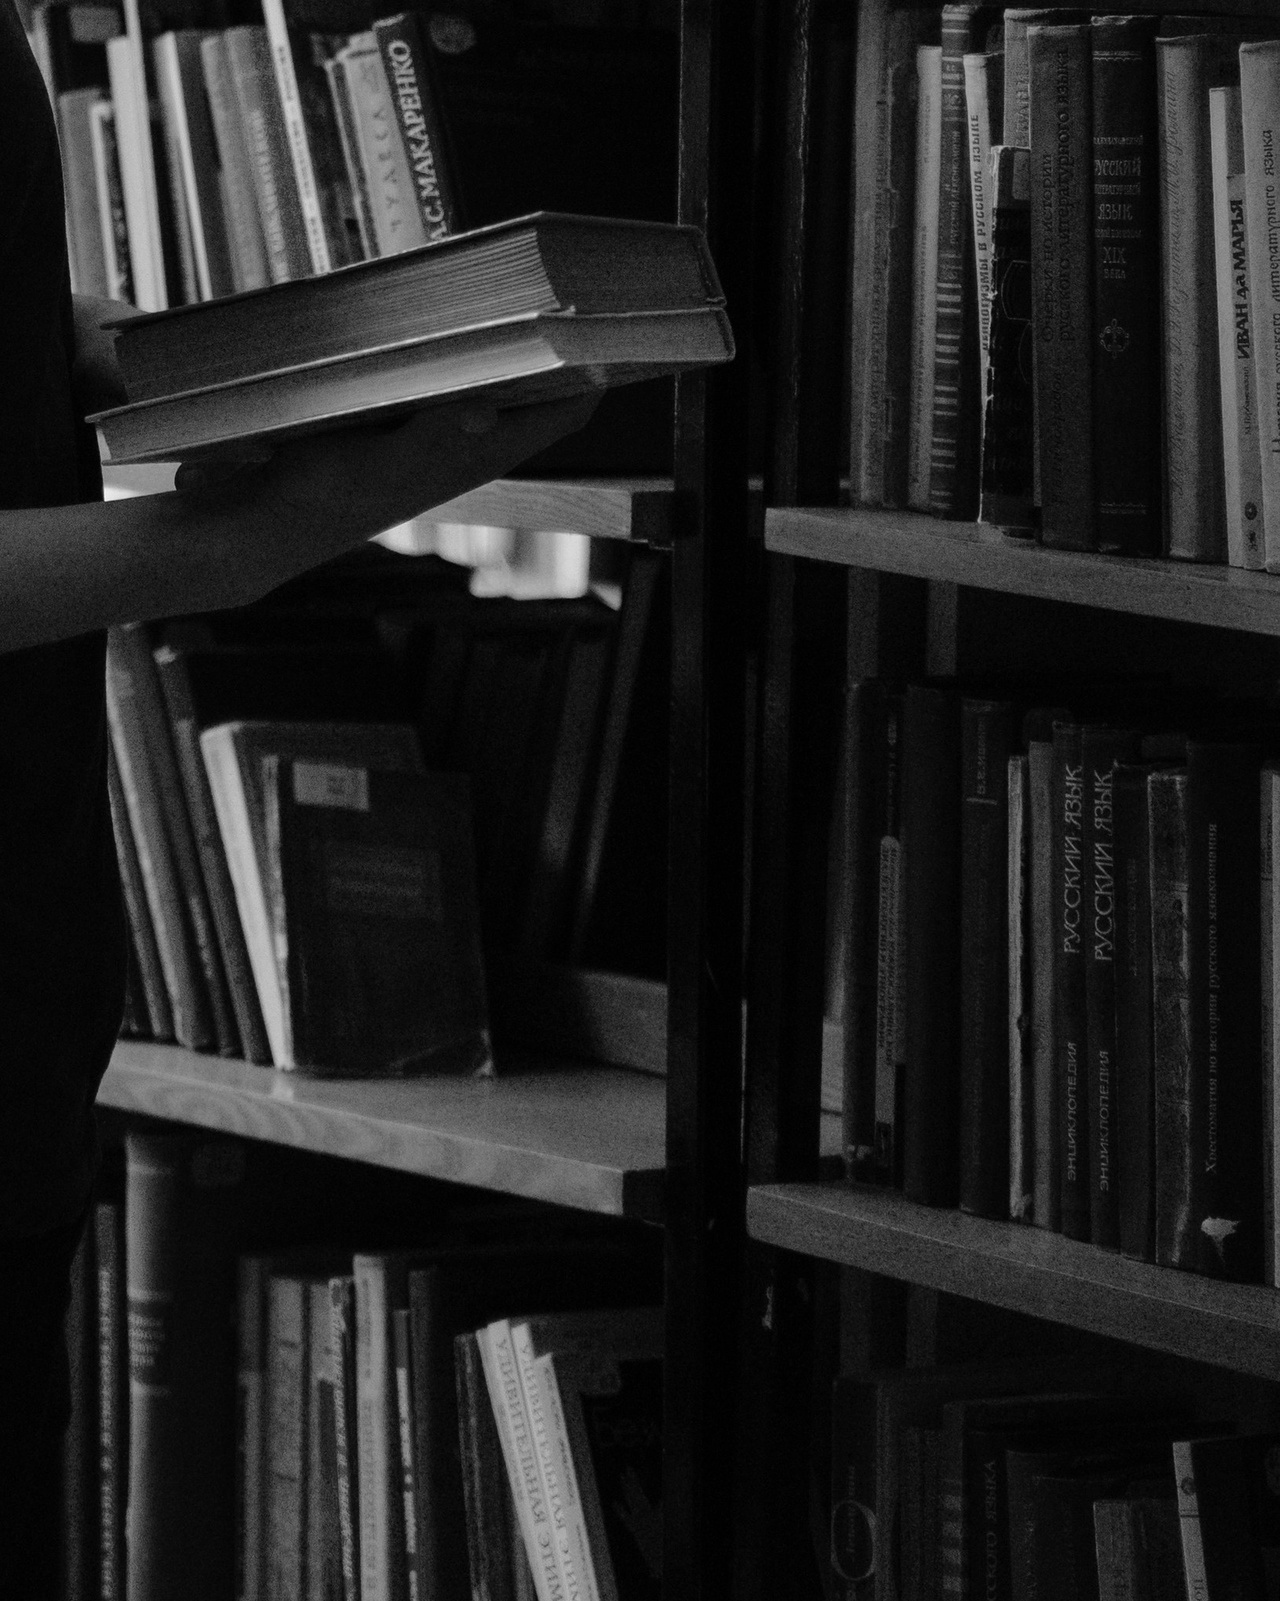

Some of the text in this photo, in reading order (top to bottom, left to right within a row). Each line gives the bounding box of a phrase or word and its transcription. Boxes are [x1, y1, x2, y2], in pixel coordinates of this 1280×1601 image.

[387, 39, 447, 241] А.С.МАКАРЕНКО
[970, 113, 981, 162] ЯЗЫКЕ
[974, 170, 986, 236] РУССКОМ
[1055, 48, 1074, 341] русского литературного языка
[1097, 203, 1133, 221] ЯЗЫК
[1262, 128, 1276, 176] языка
[977, 242, 987, 250] В
[1041, 153, 1056, 342] Очерки по истории
[1102, 246, 1127, 265] XIX
[1228, 198, 1252, 359] ИВАН да МАРЬЯ
[1063, 764, 1082, 1180] ЭНЦИКЛОПЕДИЯ РУССКИЙ ЯЗЫК
[1094, 770, 1113, 1190] ЭНЦИКЛОПЕДИЯ РУССКИЙ ЯЗЫК
[1204, 823, 1220, 1173] Хрестоматия по истории русского языкознания
[494, 1339, 548, 1524] УДИВИТЕЛЬНАЯ
[984, 1459, 996, 1601] ССКОГО ЯЗЫКА
